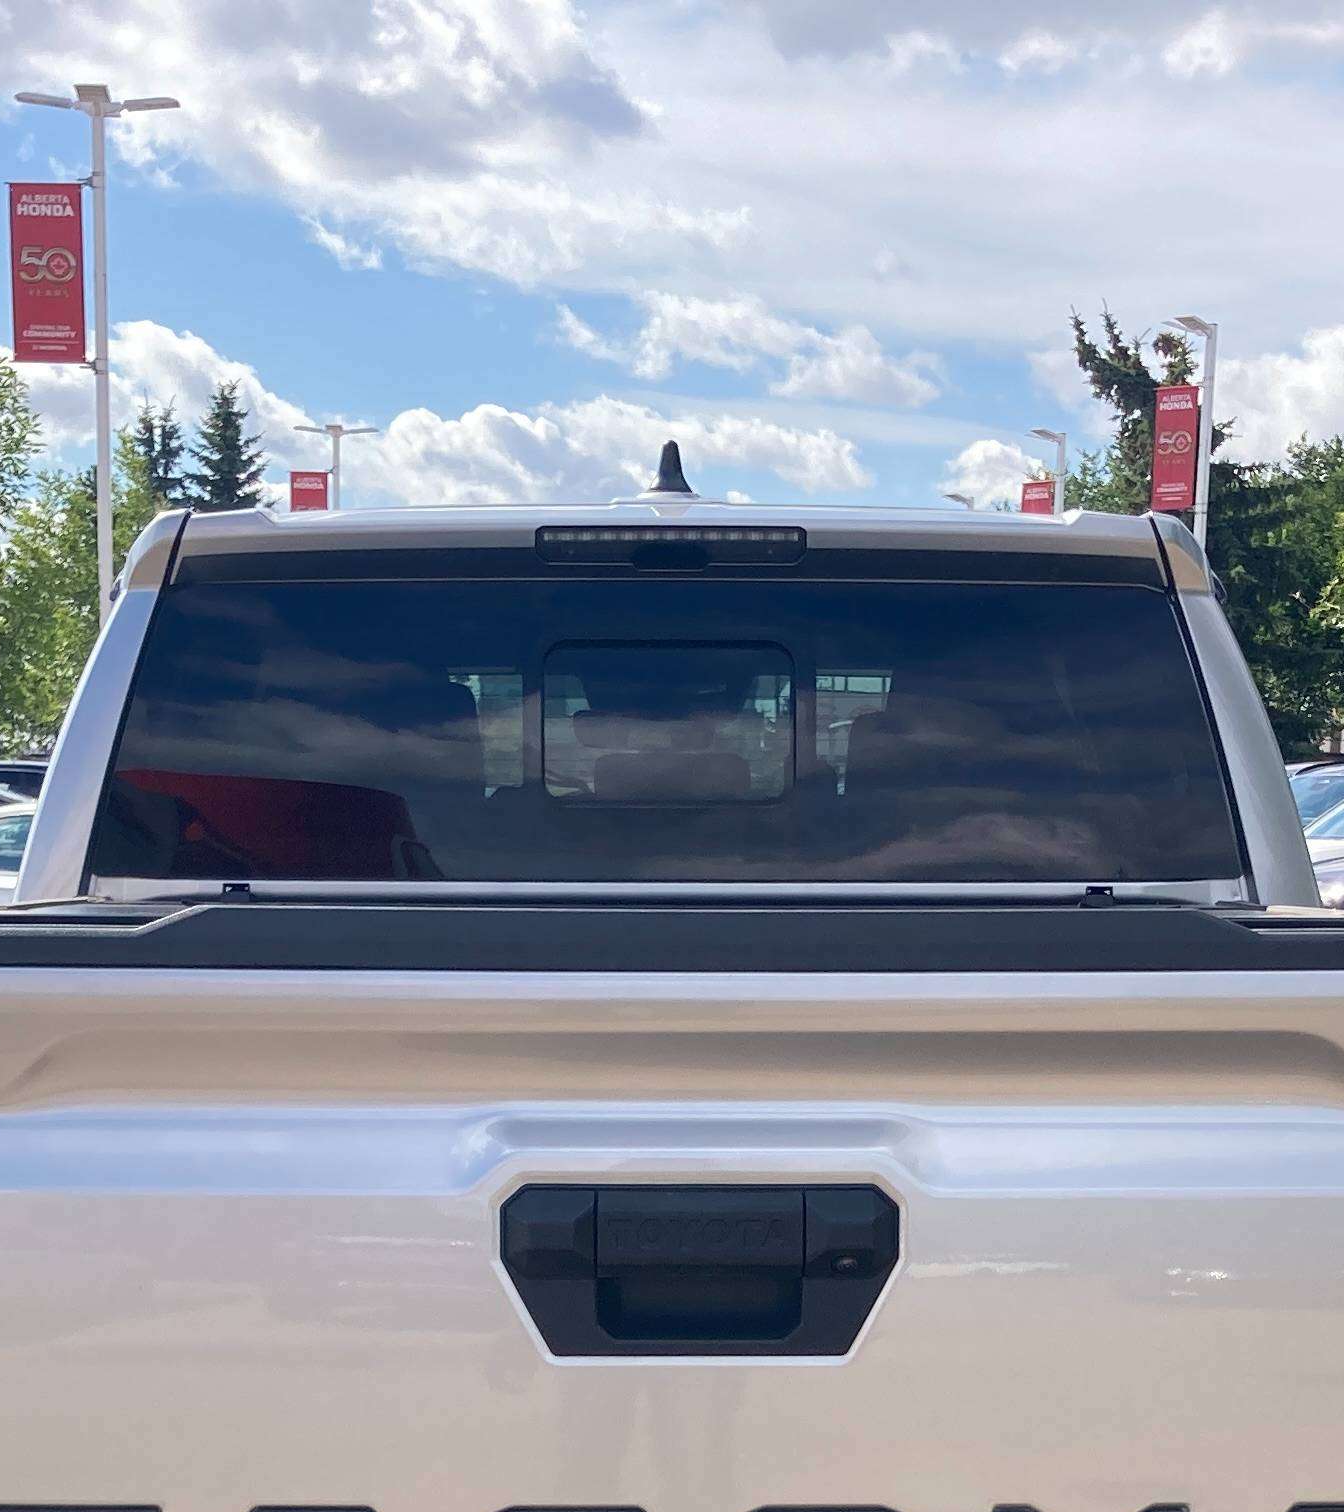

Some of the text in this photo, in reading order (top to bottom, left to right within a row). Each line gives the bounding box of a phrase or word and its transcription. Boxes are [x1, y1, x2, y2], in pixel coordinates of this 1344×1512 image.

[20, 194, 71, 204] ALBERTA
[16, 203, 75, 217] HONDA
[19, 245, 77, 284] 50
[1159, 401, 1194, 411] HONDA
[1157, 430, 1193, 455] 50
[606, 1217, 786, 1249] TOYOTA
